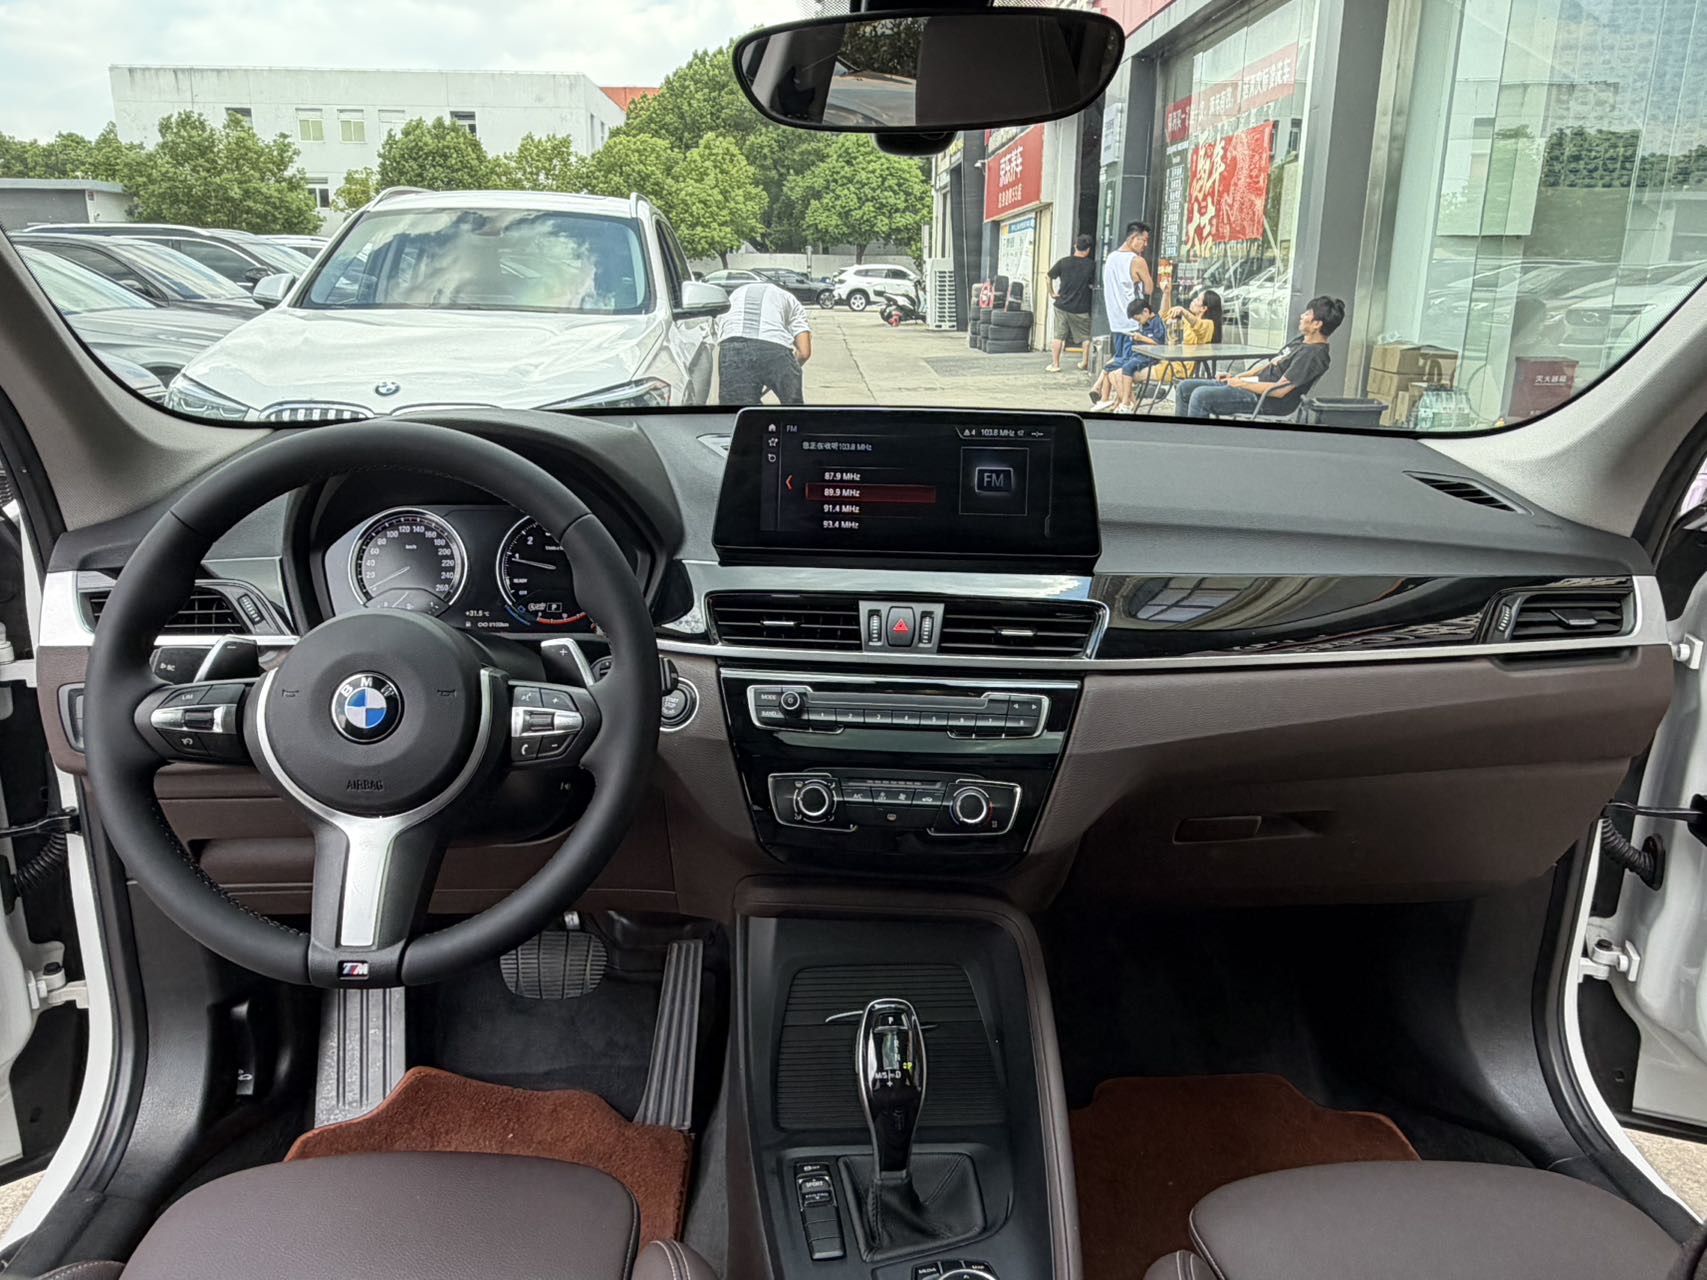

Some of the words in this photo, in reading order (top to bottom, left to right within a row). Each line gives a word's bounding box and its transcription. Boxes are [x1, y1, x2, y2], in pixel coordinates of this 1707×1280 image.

[824, 472, 841, 480] 87.9
[984, 472, 1004, 487] FM
[841, 521, 859, 529] MHz
[527, 536, 533, 545] 2
[346, 780, 384, 791] AIRBAG
[888, 1016, 894, 1025] P
